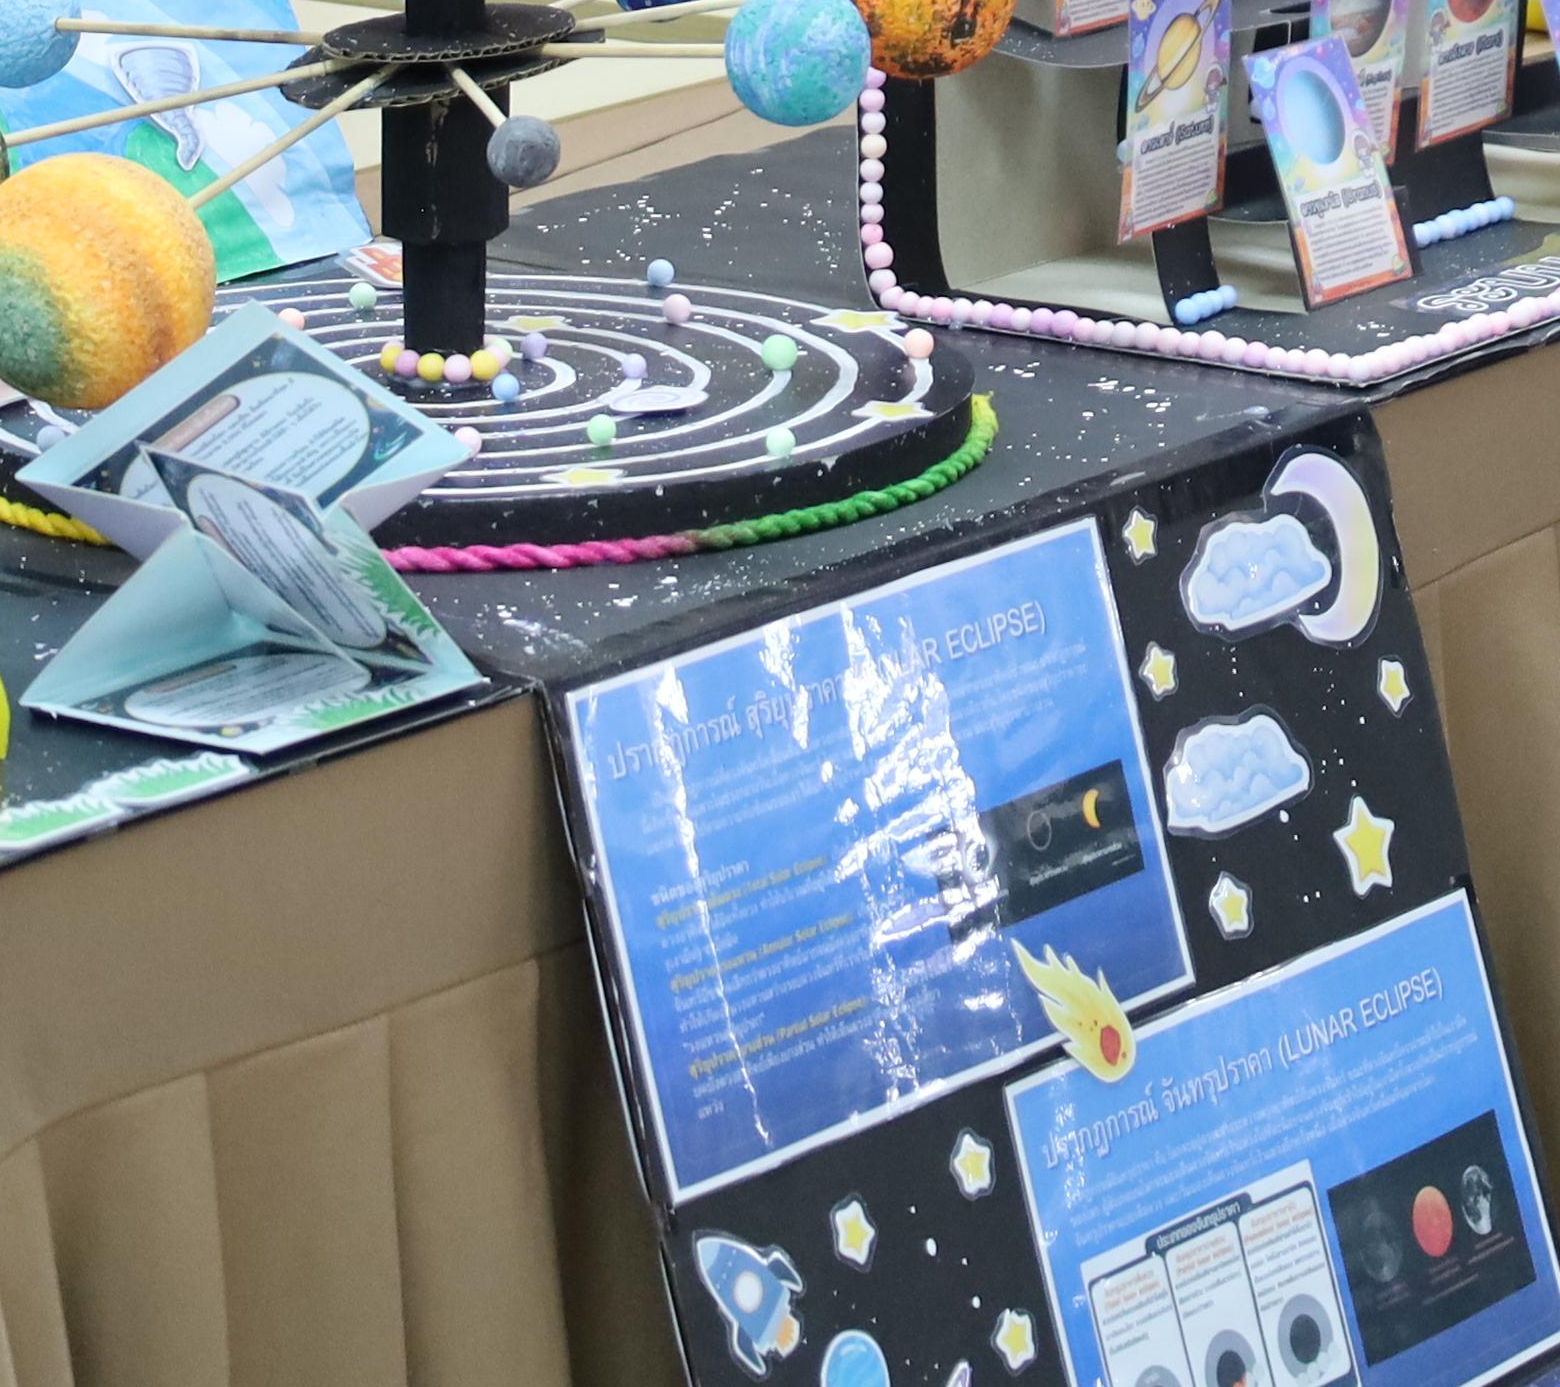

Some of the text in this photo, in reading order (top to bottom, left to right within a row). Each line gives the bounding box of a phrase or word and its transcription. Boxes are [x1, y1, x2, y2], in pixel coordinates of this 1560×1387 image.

[944, 599, 1047, 660] ECLIPSE)
[1160, 1047, 1274, 1113] จันทรุปราคา
[1278, 1007, 1358, 1070] (LUNAR
[1359, 967, 1444, 1028] ECLIPSE)
